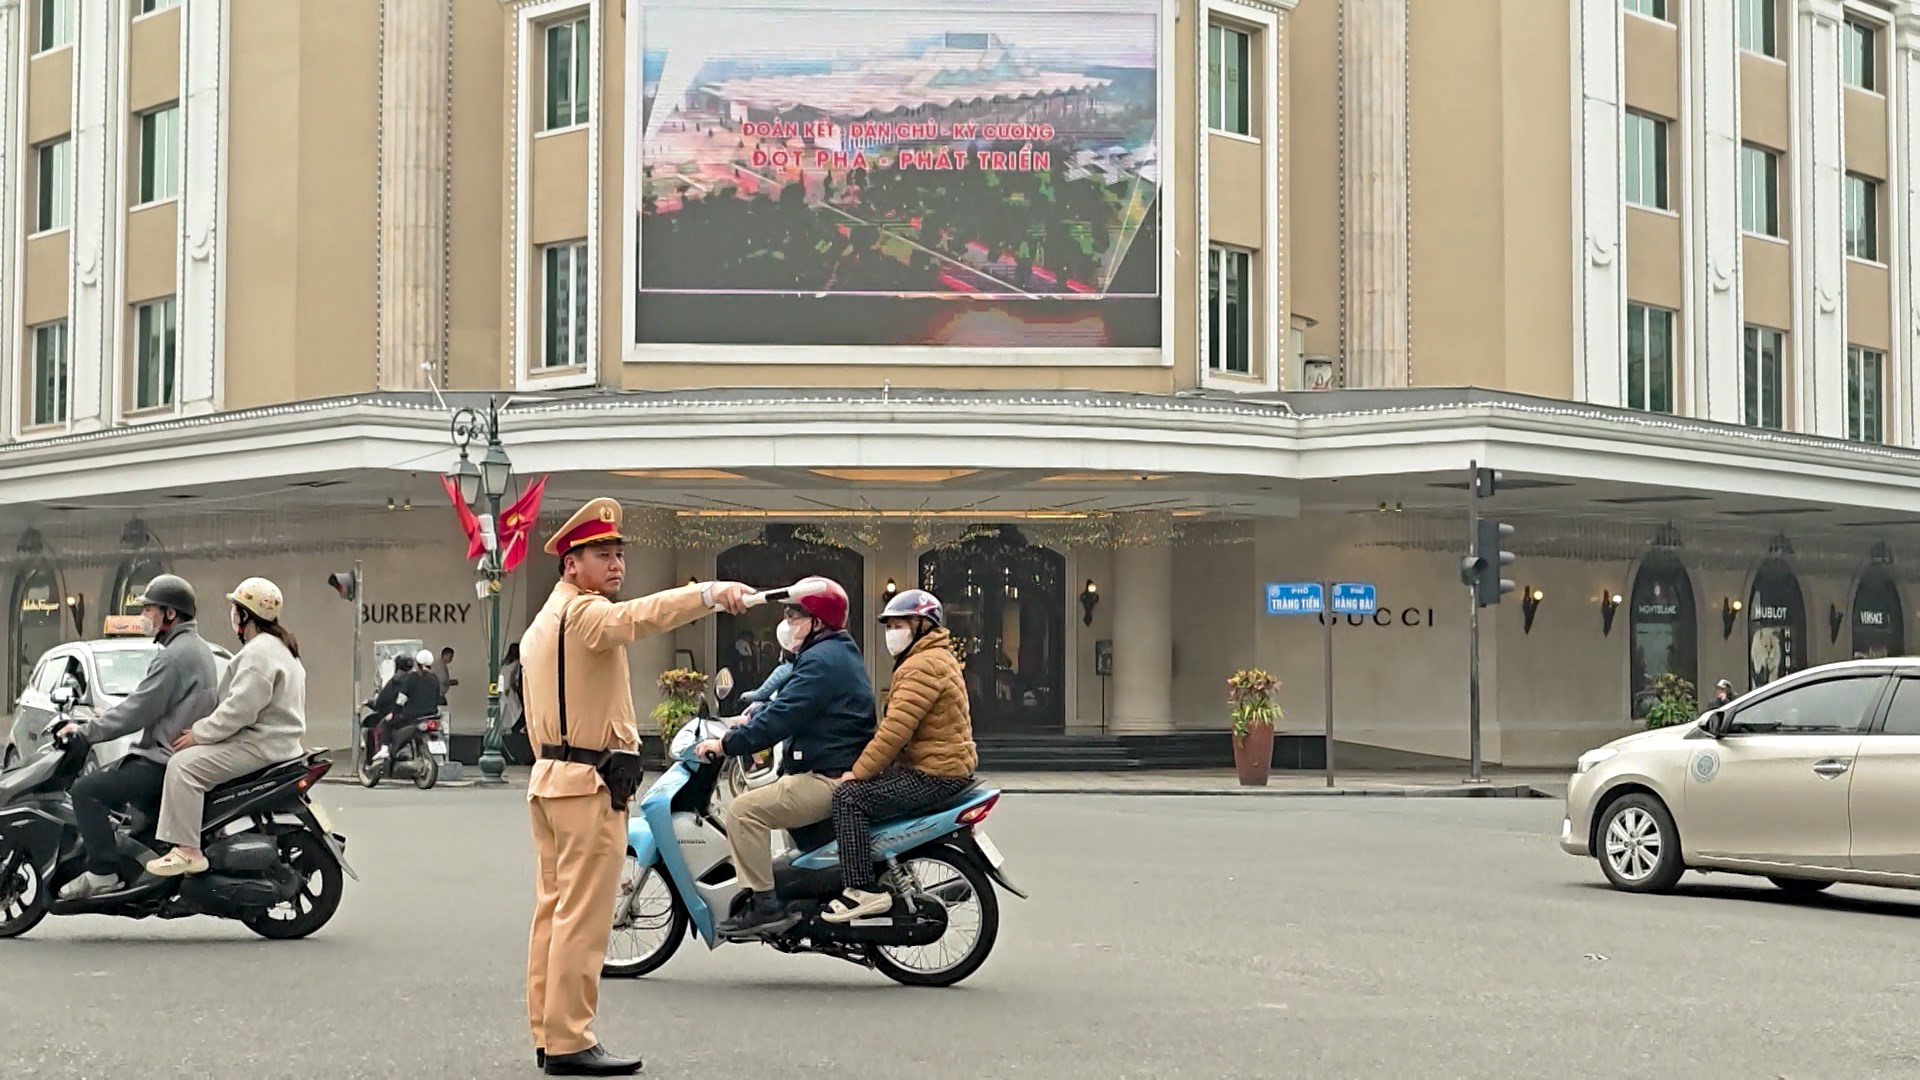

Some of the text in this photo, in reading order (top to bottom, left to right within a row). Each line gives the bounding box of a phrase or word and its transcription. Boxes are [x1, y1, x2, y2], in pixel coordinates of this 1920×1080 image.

[743, 116, 798, 137] ĐOÀN
[804, 117, 833, 137] KẾT
[851, 118, 891, 138] DÂN
[896, 117, 938, 139] CHỦ
[953, 118, 977, 139] KỶ
[752, 145, 802, 174] ĐỘT
[816, 147, 868, 170] PHÁ
[899, 145, 967, 170] PHÁT
[977, 142, 1051, 170] TRIỂN
[1291, 586, 1309, 595] PHỐ
[361, 603, 471, 624] BURBERRY
[1755, 606, 1787, 619] HUBLOT
